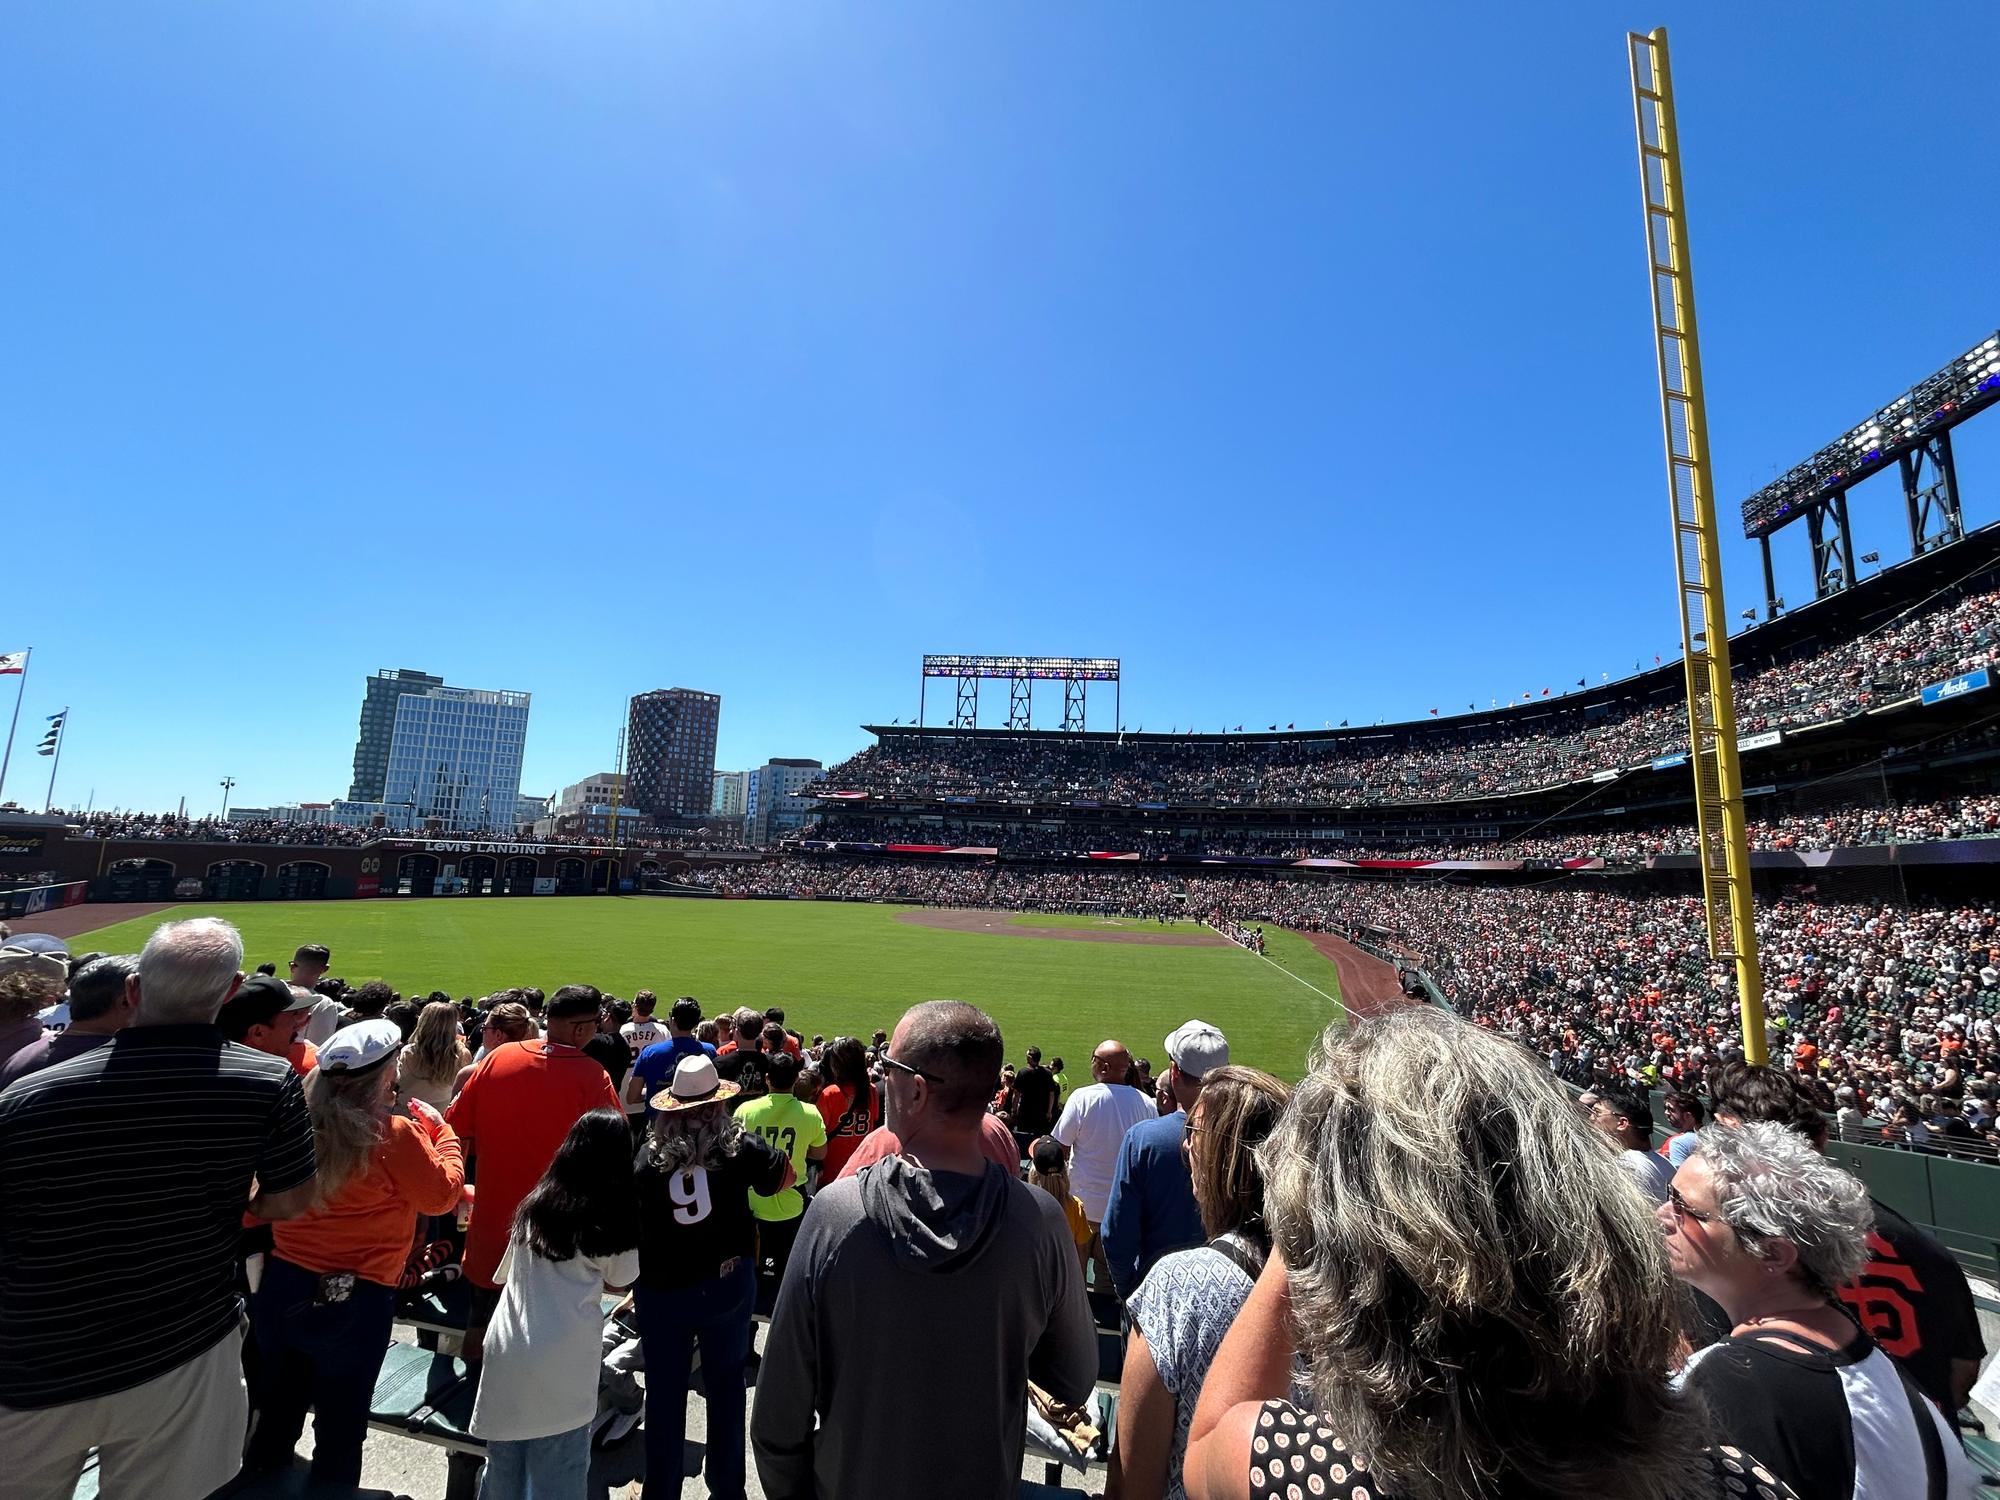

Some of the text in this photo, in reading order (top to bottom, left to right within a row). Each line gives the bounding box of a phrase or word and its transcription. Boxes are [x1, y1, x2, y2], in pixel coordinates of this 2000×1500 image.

[1937, 679, 1970, 698] Alaska
[476, 844, 547, 855] LANDING
[625, 1030, 656, 1044] POSEY
[836, 1111, 870, 1137] 28
[668, 1164, 712, 1225] 9
